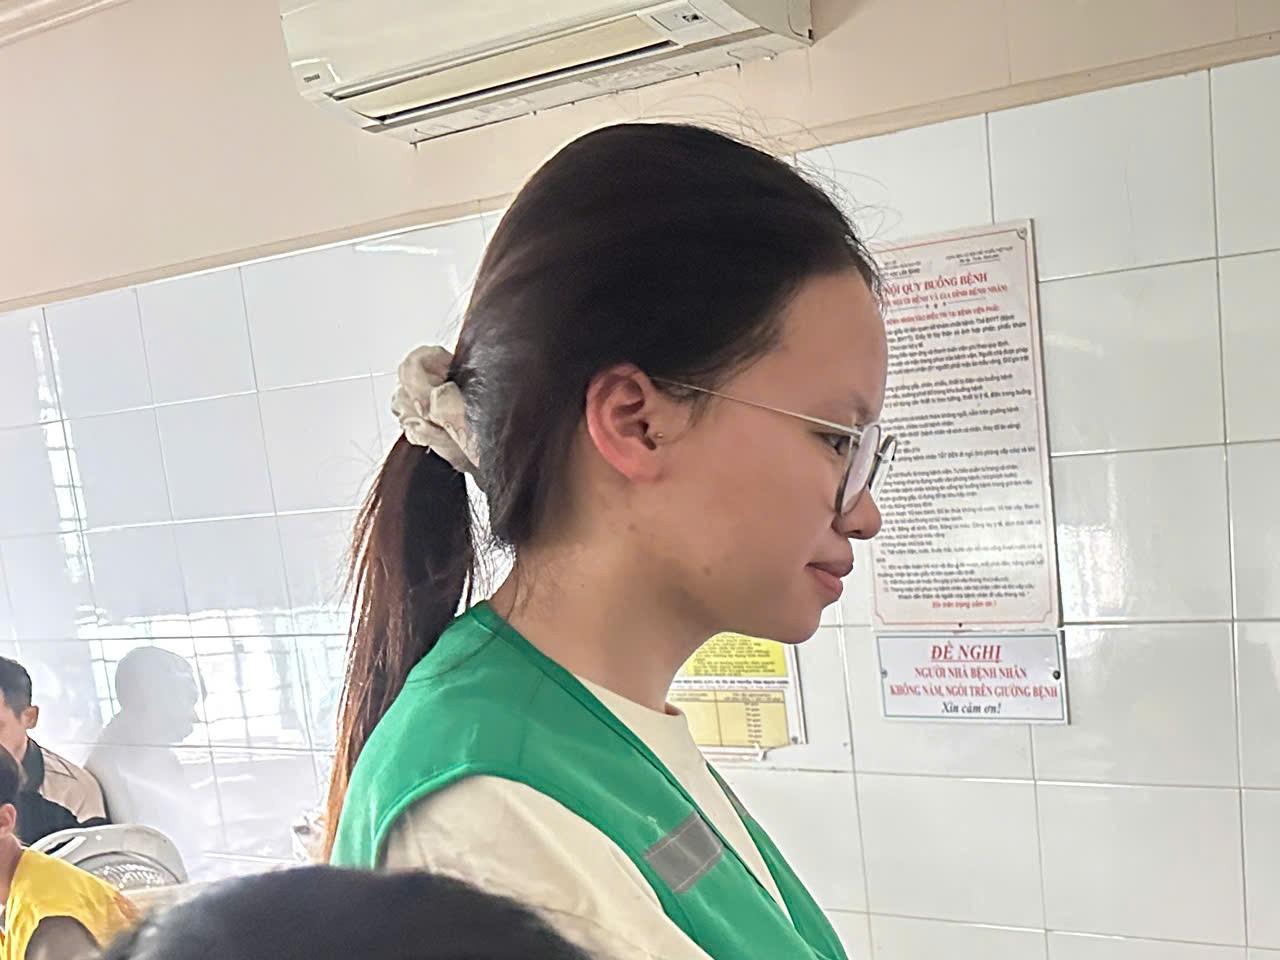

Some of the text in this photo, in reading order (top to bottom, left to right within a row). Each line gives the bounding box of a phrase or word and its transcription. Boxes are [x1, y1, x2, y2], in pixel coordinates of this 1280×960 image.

[902, 281, 921, 294] QUY
[960, 271, 988, 286] BỆNH
[931, 640, 1003, 663] ĐỀ NGHỊ
[915, 664, 1027, 681] NGƯỜI NHÀ BỆNH NHÂN
[890, 682, 921, 697] KHÔNG
[970, 682, 993, 697] TRÊN
[994, 683, 1031, 698] GIƯỜNG
[1033, 685, 1058, 701] BỆNH
[941, 702, 959, 714] Xin
